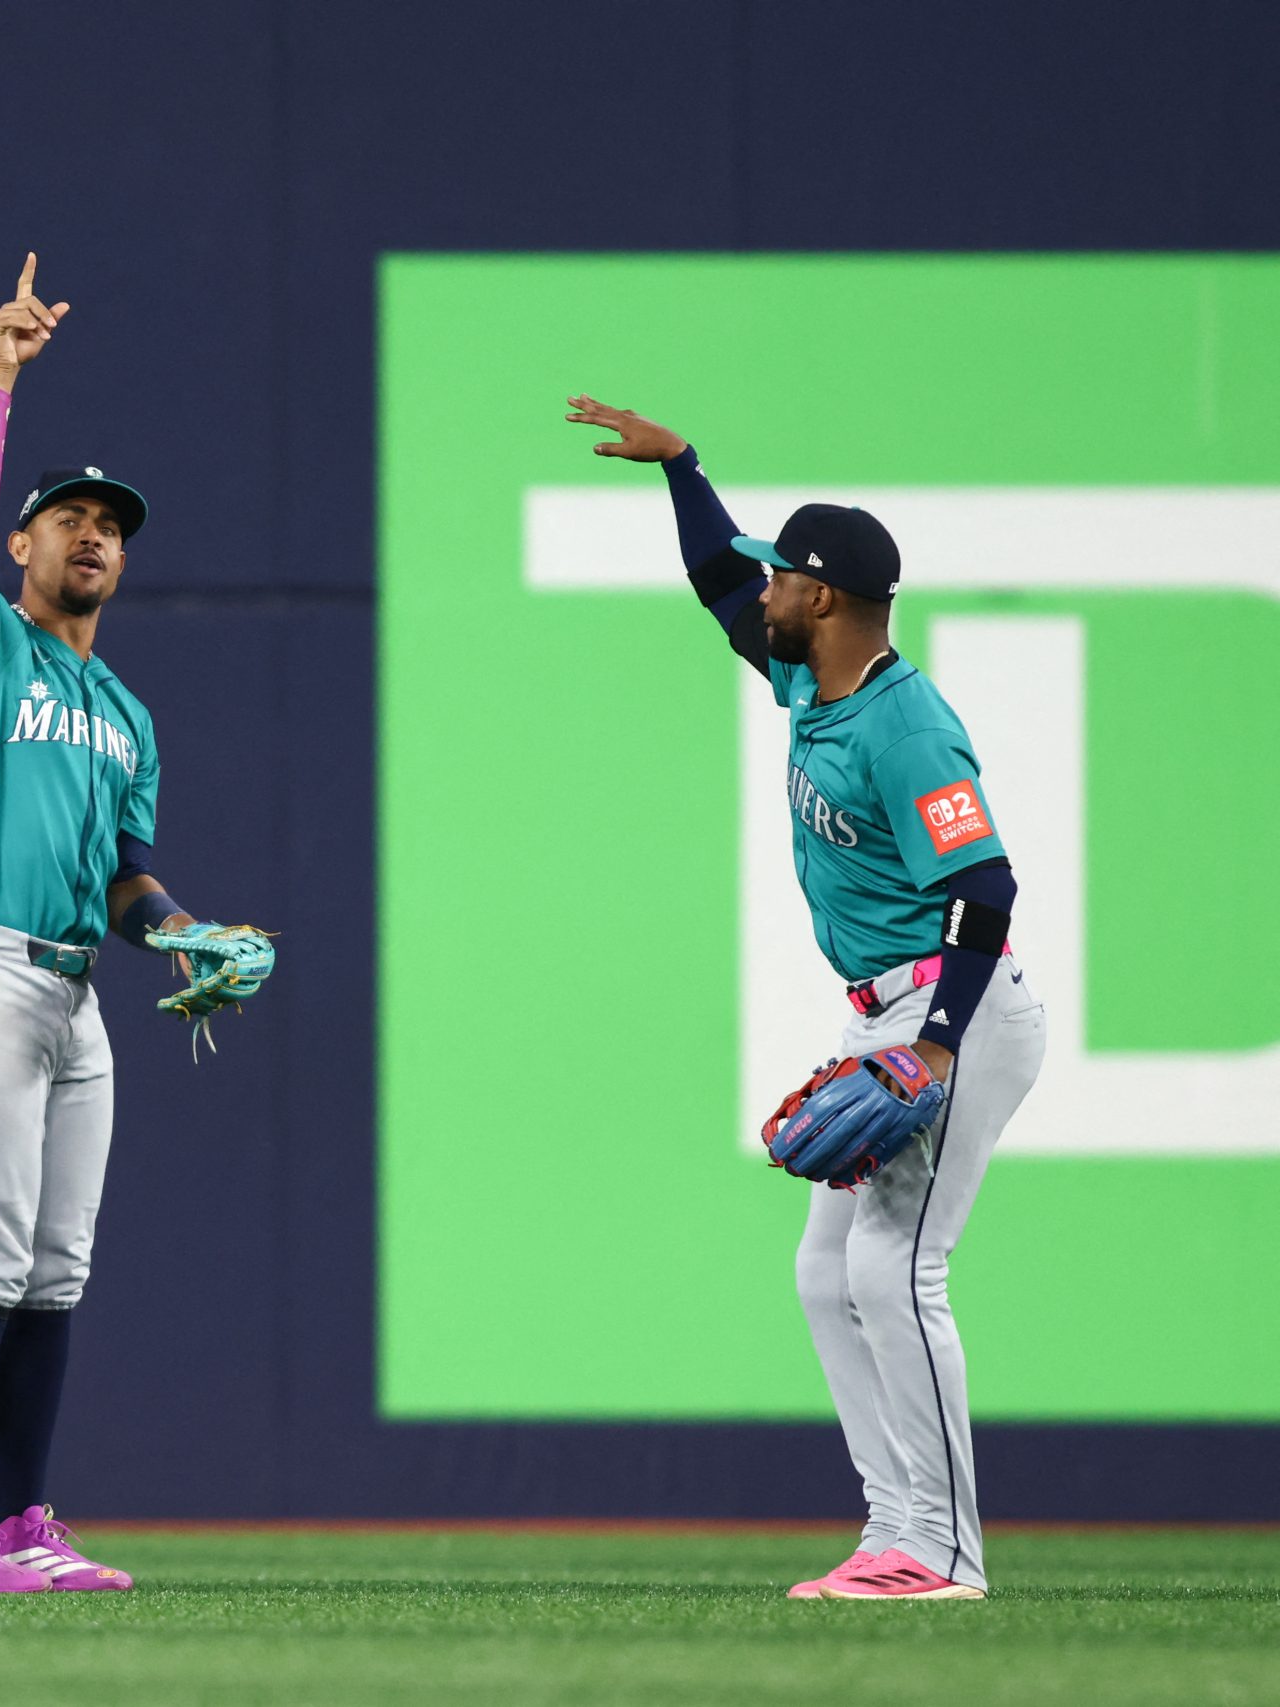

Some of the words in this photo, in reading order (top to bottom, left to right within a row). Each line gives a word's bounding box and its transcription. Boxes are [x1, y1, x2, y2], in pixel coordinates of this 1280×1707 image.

[5, 698, 137, 778] MARINE
[951, 791, 977, 817] 2
[938, 815, 978, 836] NINTENDO
[940, 821, 984, 843] SWITCH
[928, 1015, 950, 1026] adidas
